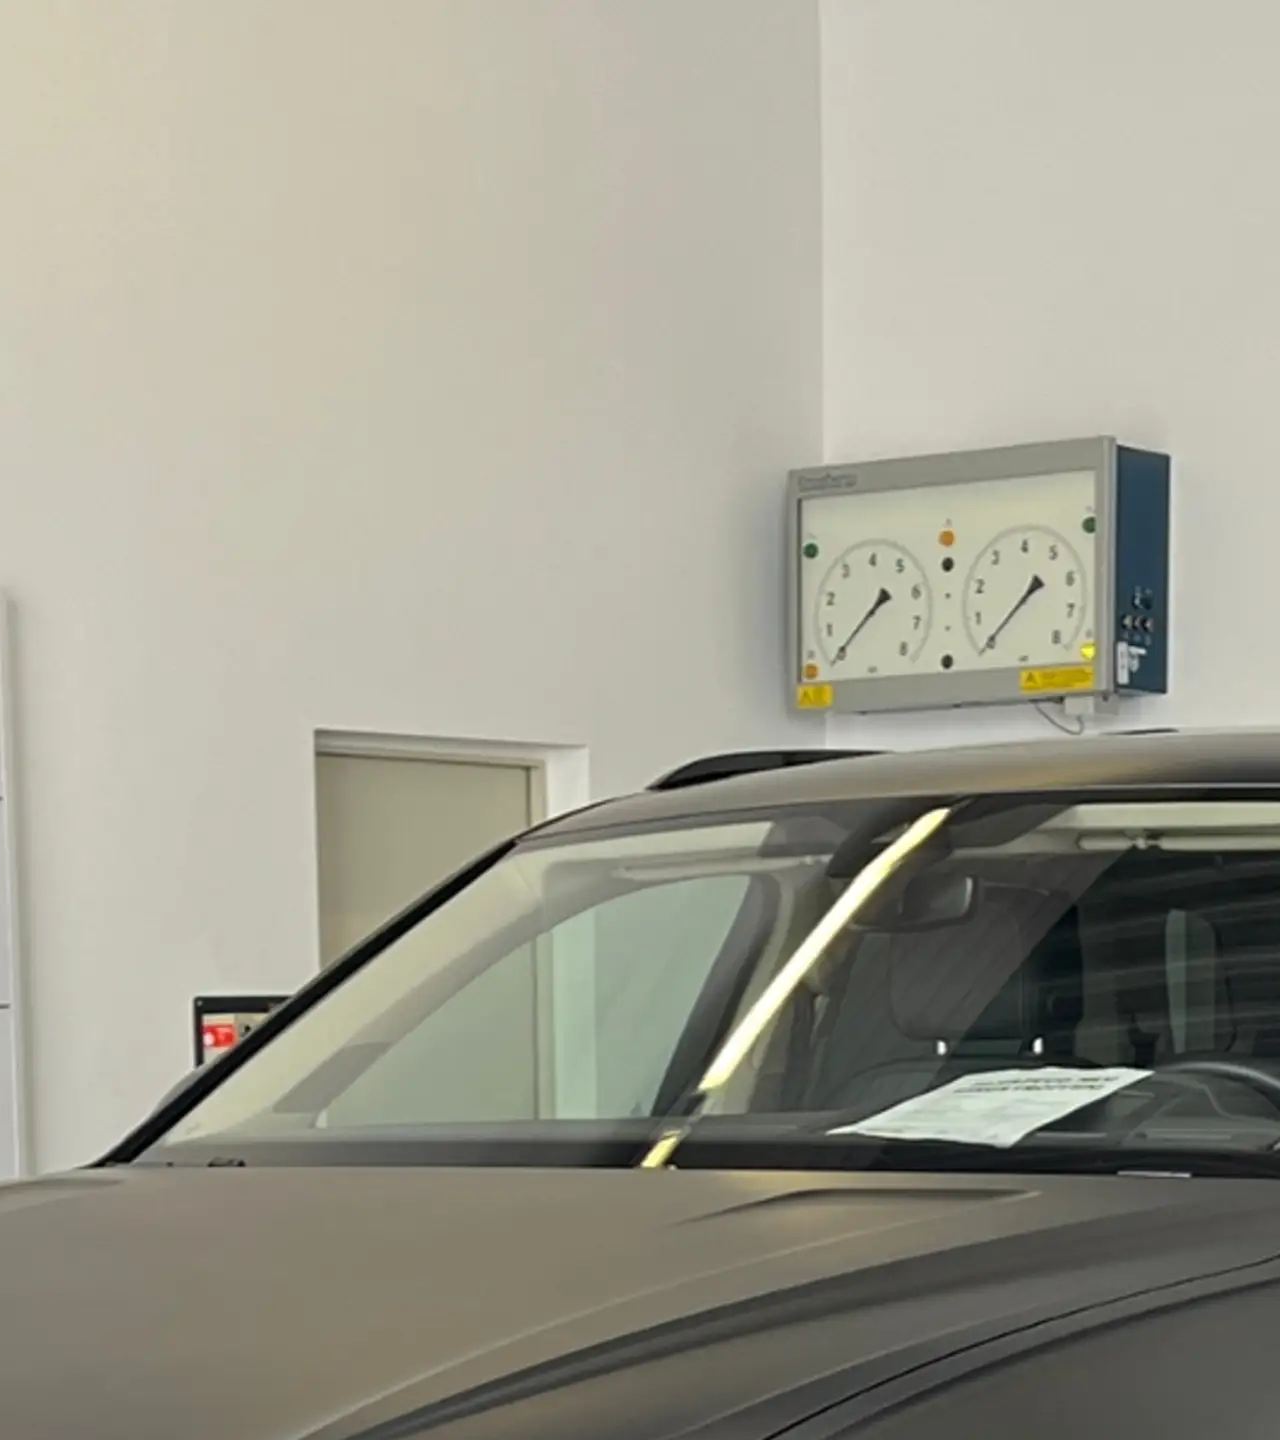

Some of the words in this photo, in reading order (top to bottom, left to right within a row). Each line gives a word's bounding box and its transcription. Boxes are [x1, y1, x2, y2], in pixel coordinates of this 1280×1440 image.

[1020, 539, 1029, 553] 4
[1048, 544, 1058, 560] 5
[868, 552, 877, 567] 4
[991, 549, 1000, 565] 3
[842, 563, 851, 579] 3
[895, 558, 905, 574] 5
[975, 578, 985, 594] 2
[1065, 570, 1075, 586] 6
[826, 592, 836, 606] 2
[911, 583, 922, 600] 6
[975, 611, 982, 625] 1
[1066, 602, 1075, 618] 7
[826, 623, 833, 637] 1
[912, 615, 922, 630] 7
[1051, 629, 1061, 645] 8
